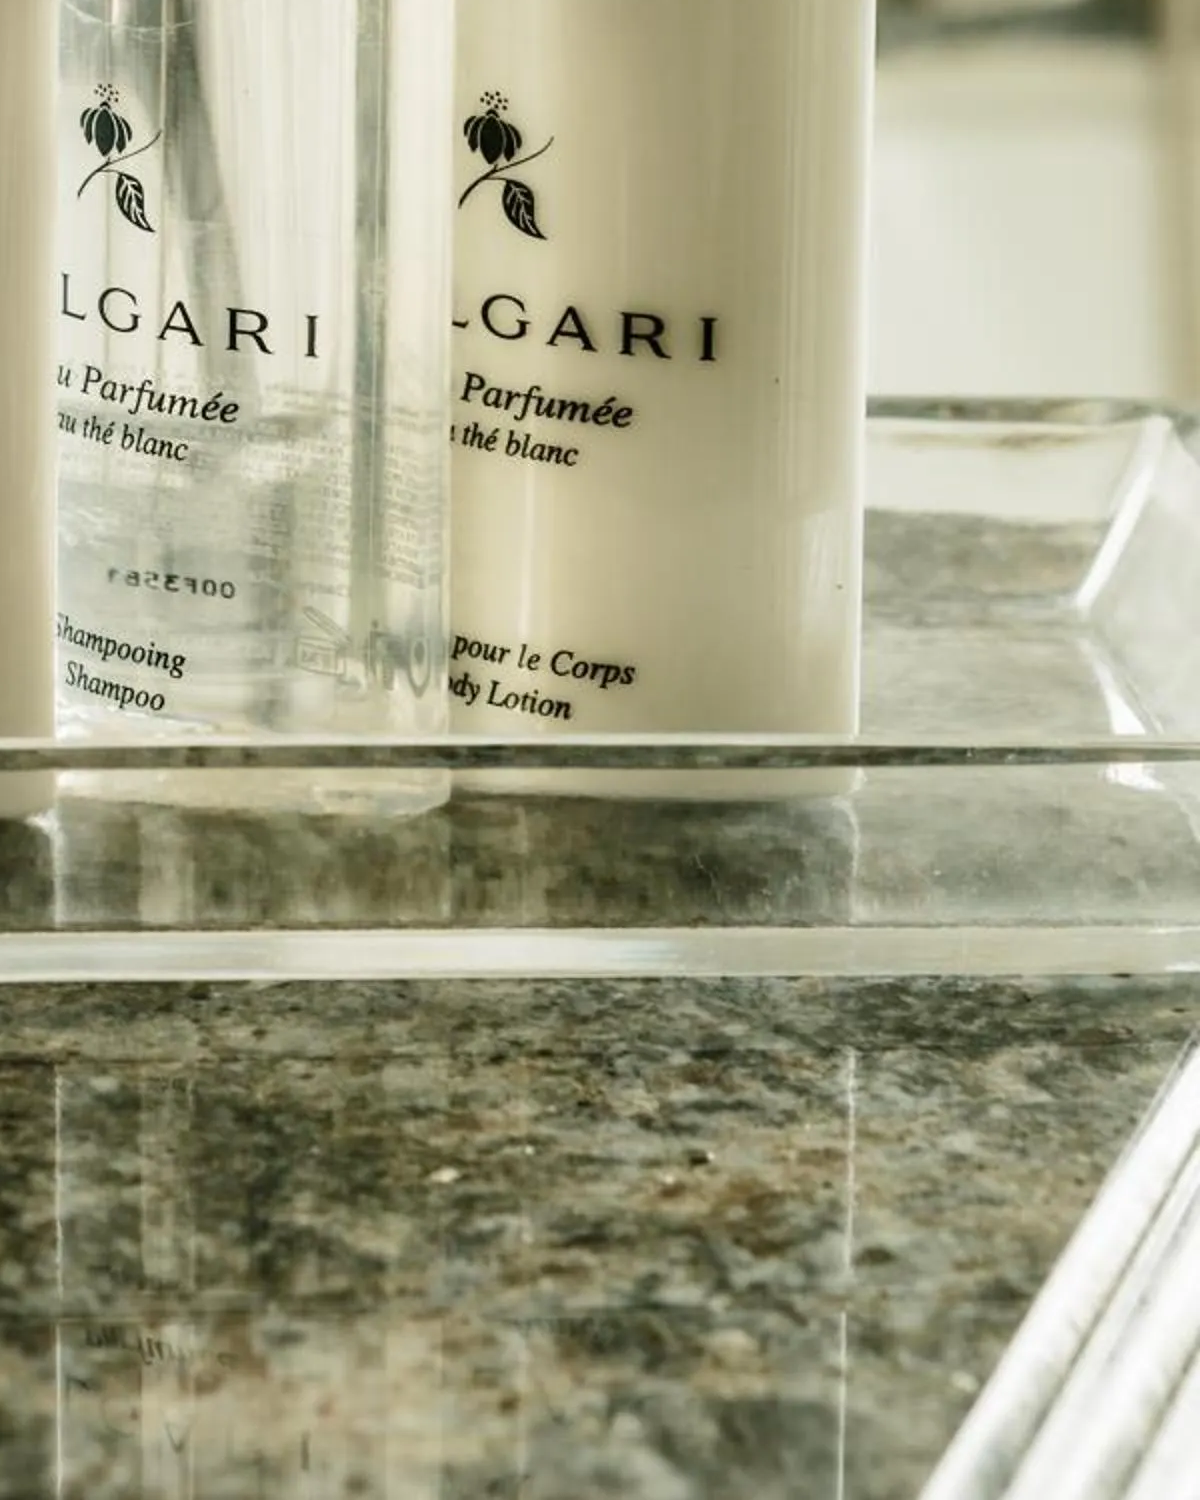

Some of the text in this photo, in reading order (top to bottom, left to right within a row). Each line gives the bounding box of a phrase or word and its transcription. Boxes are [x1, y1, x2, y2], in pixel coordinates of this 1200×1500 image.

[61, 272, 319, 358] LGARI
[452, 293, 718, 362] GARI
[80, 364, 240, 424] Parfumée
[460, 371, 634, 429] Parfumée
[82, 415, 116, 445] thé
[121, 423, 189, 461] blanc
[461, 421, 500, 453] thé
[505, 429, 579, 467] blanc
[65, 660, 166, 712] Shampoo
[451, 635, 636, 689] pour le Corps
[486, 679, 573, 721] Lotion
